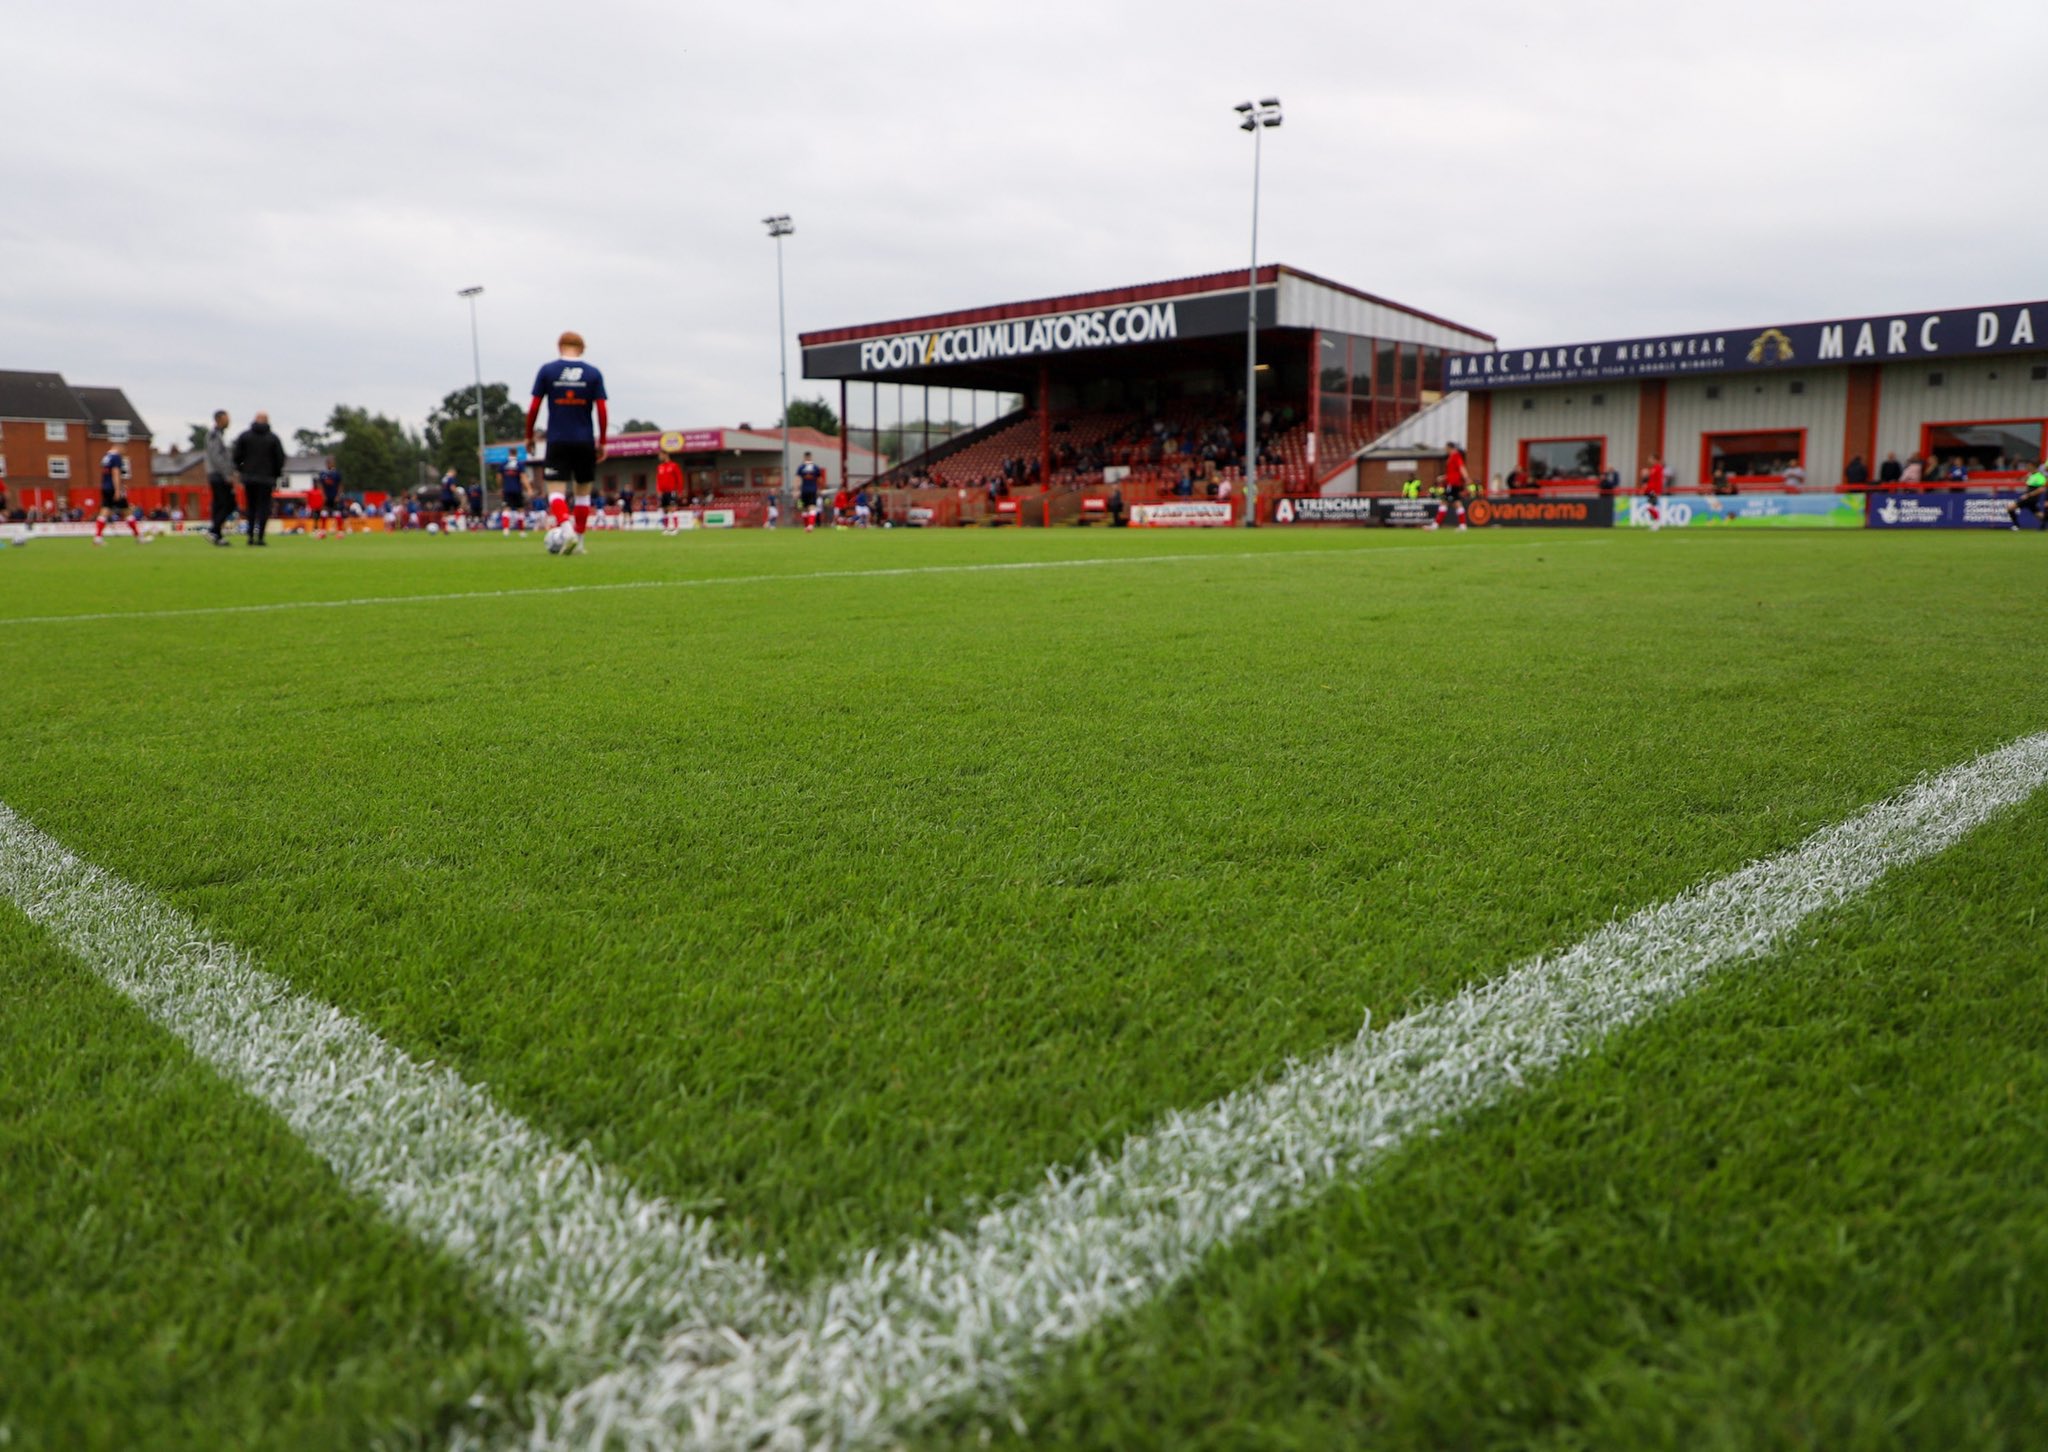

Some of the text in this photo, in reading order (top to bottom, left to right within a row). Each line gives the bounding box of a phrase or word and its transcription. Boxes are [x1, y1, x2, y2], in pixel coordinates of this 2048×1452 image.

[860, 302, 1178, 371] FOOTYACCUMULATORS.COM
[1449, 337, 1726, 376] MARC DARCY MENSWEAR
[1818, 315, 1942, 360] MARC
[1490, 501, 1588, 520] vanarama
